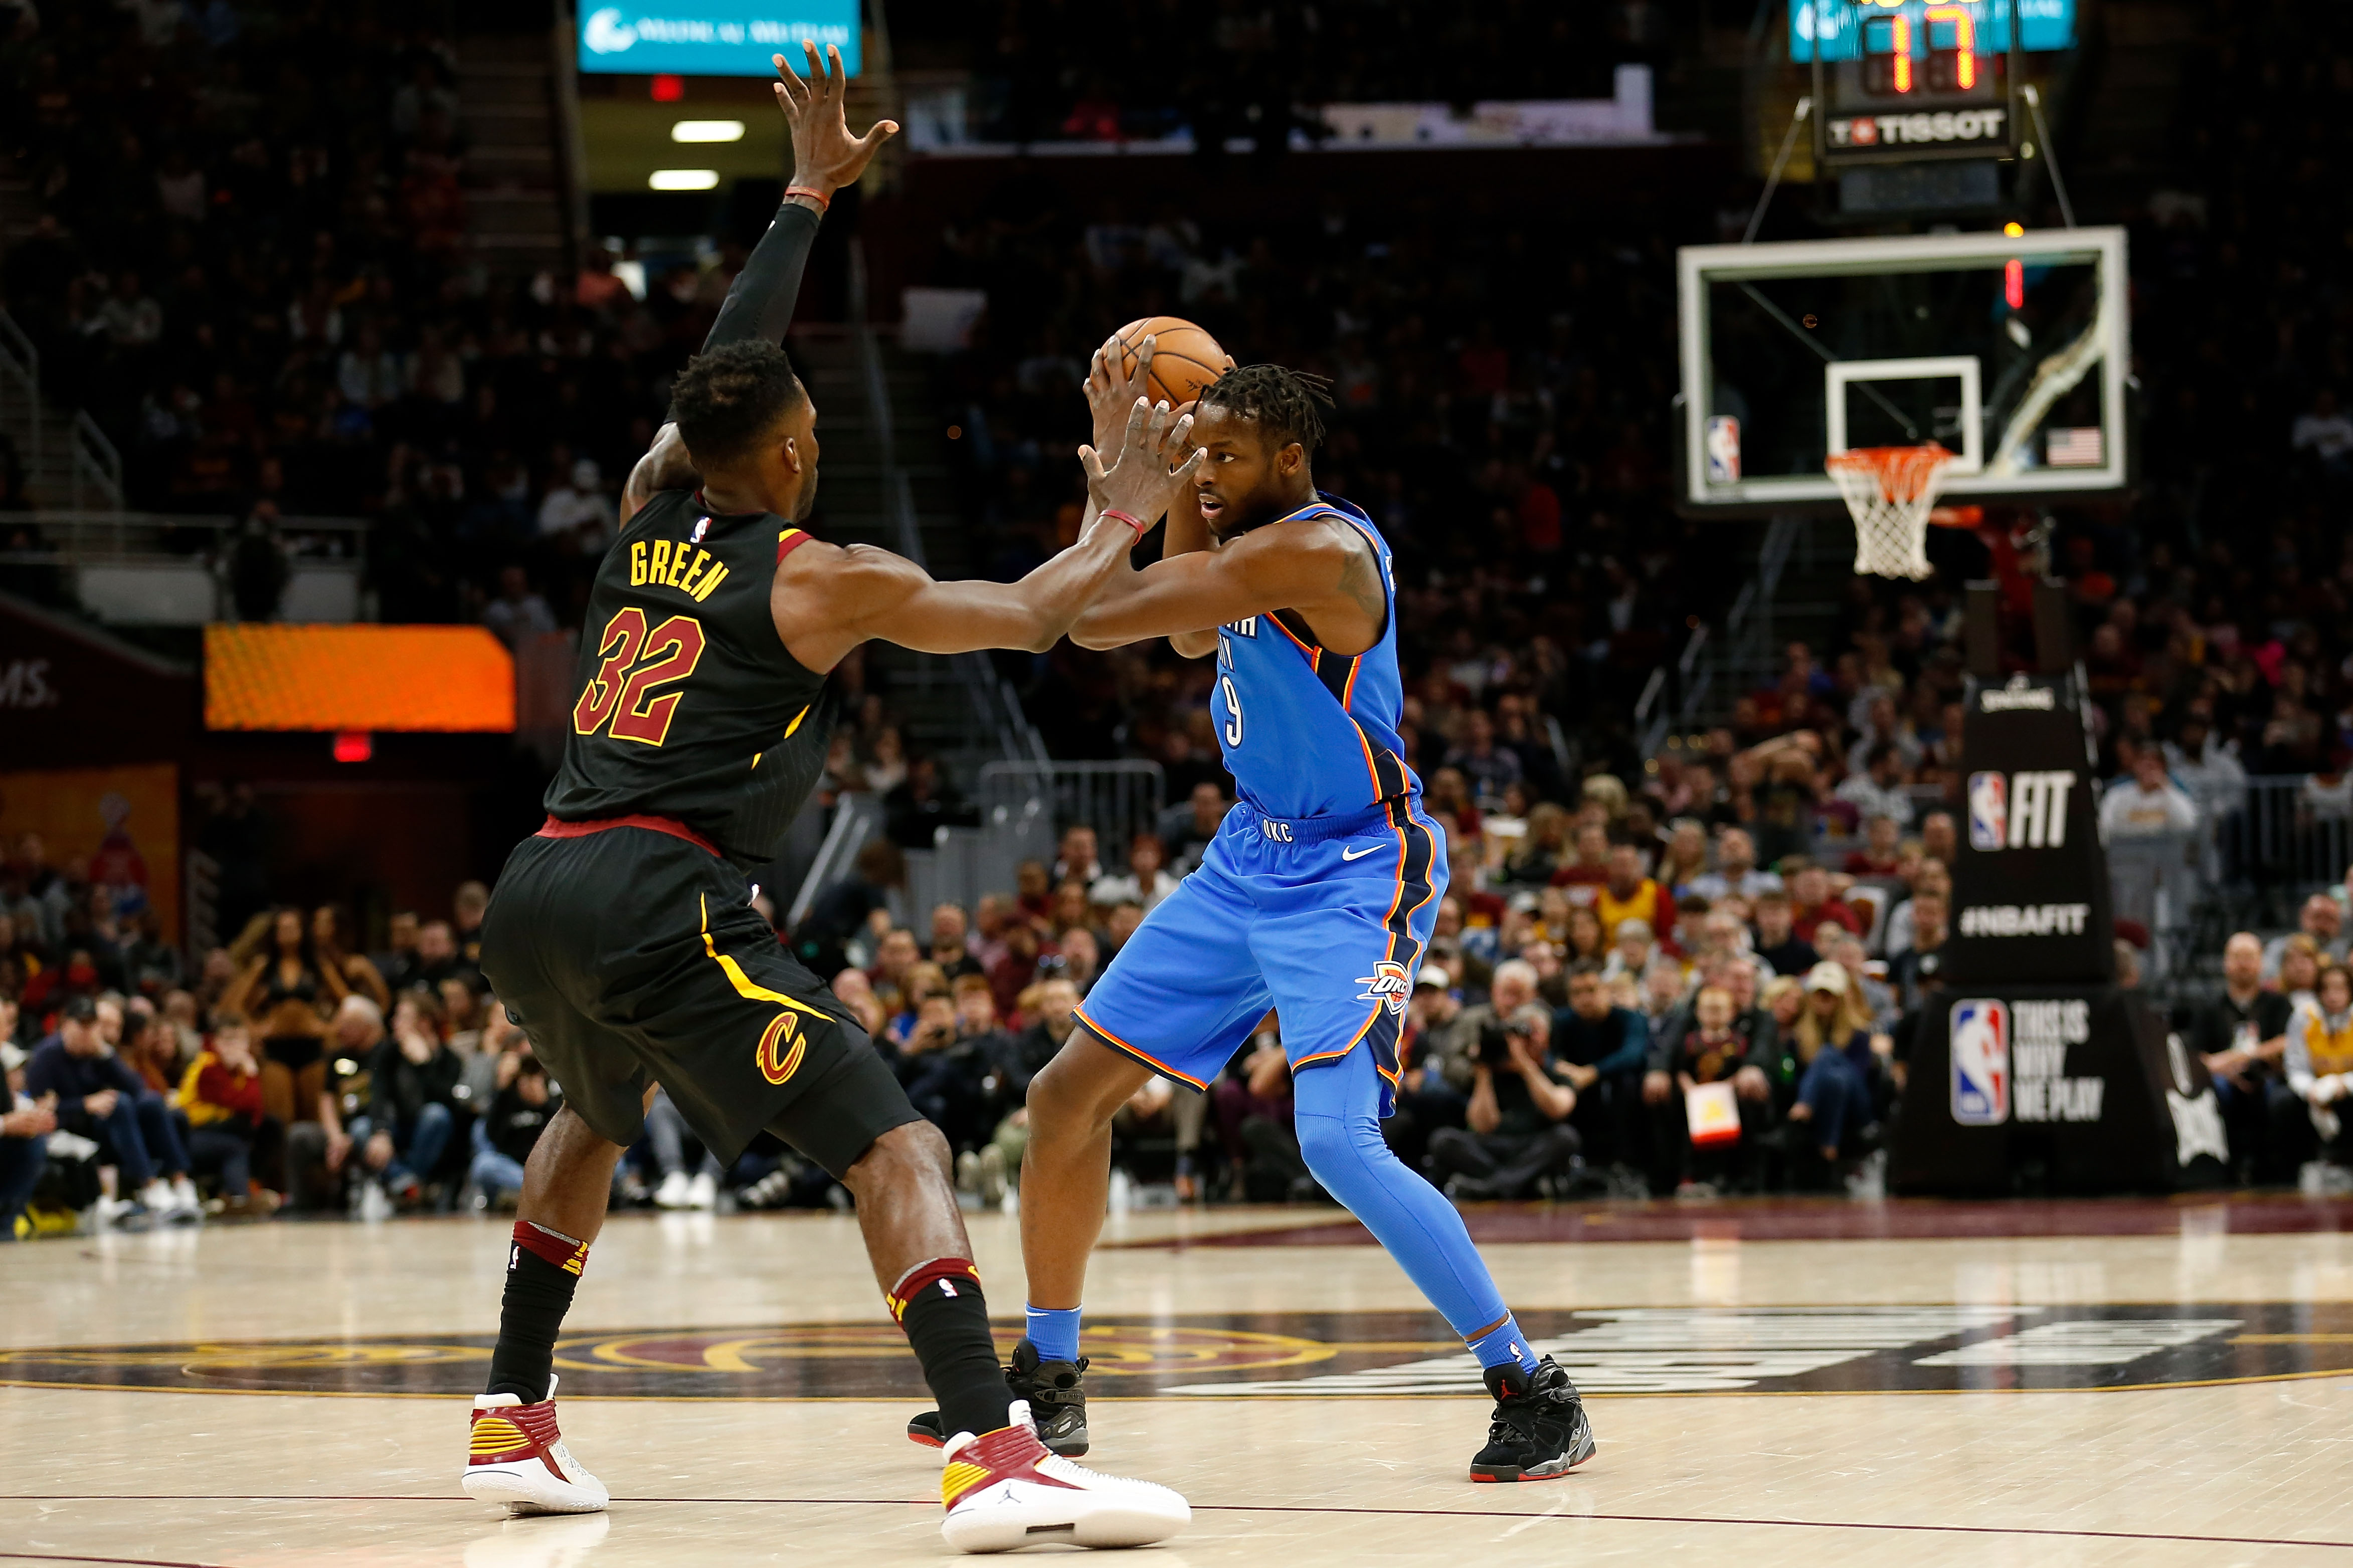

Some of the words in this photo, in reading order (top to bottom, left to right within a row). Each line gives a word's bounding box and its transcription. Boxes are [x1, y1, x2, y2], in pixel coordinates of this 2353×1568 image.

[1892, 5, 1975, 93] 17
[1874, 108, 2005, 145] TISSOT
[630, 539, 730, 603] GREEN
[573, 607, 706, 747] 32
[1220, 673, 1243, 749] 9
[1263, 818, 1294, 843] OKC
[2008, 770, 2077, 849] FIT
[1959, 903, 2091, 937] #NBAFIT
[1371, 975, 1407, 994] OKC
